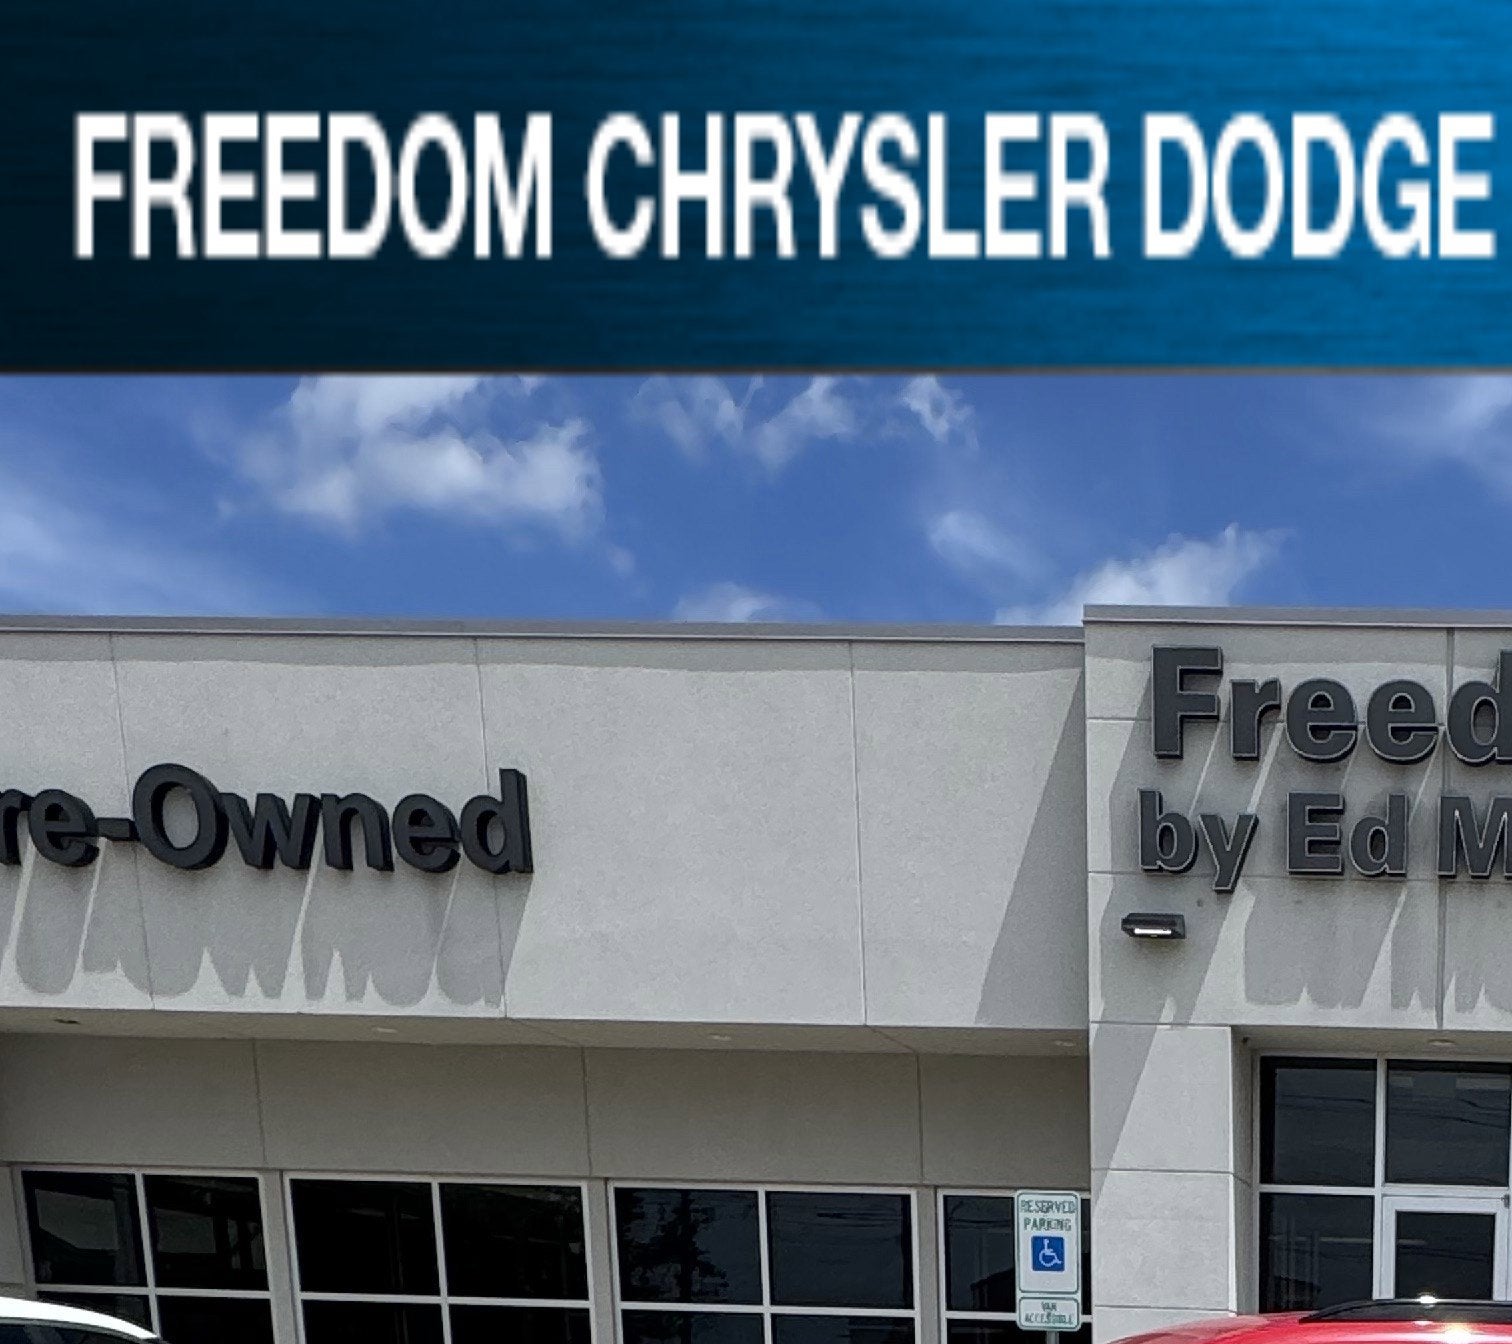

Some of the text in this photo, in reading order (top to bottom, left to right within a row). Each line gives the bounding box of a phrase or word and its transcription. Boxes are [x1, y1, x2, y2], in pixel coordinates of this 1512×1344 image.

[1137, 789, 1259, 892] by
[1284, 791, 1411, 878] Ed
[1020, 1200, 1076, 1214] RESERVED
[1023, 1218, 1073, 1231] PARKING
